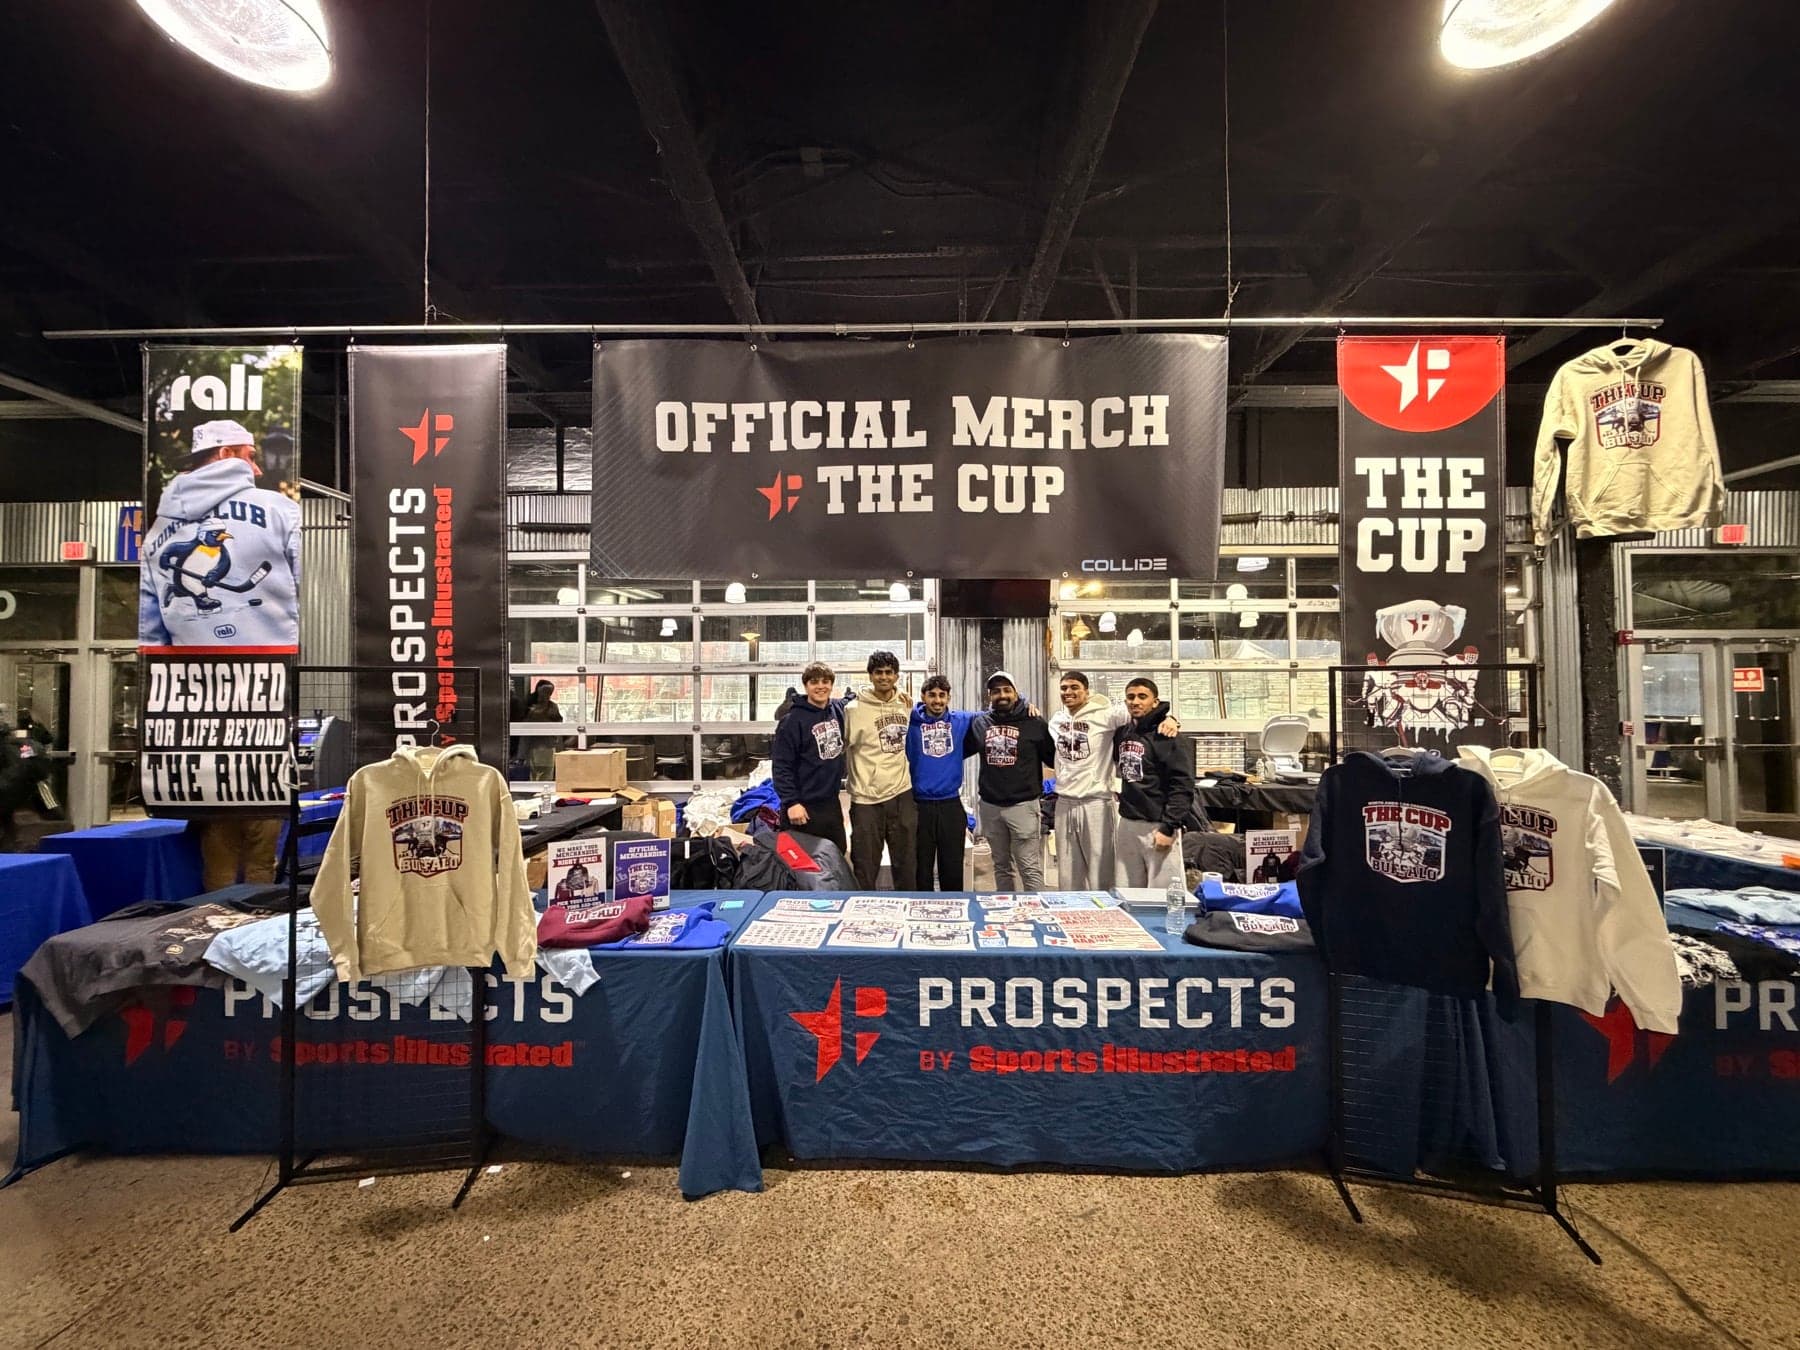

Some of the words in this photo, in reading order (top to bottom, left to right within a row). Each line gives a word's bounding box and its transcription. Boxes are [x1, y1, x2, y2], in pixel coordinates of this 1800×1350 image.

[655, 400, 927, 453] OFFICIAL
[952, 395, 1170, 450] MERCH
[817, 463, 934, 515] THE
[957, 463, 1065, 514] CUP
[1354, 457, 1485, 510] THE
[431, 487, 453, 626] Illustrated
[1081, 558, 1167, 571] COLLIDE
[1355, 517, 1486, 573] CUP
[147, 663, 286, 712] DESIGNED
[435, 629, 458, 723] Sports
[145, 719, 175, 746] FOR
[181, 719, 220, 746] LIFE
[223, 719, 286, 746] BEYOND
[147, 754, 204, 801] THE
[215, 754, 286, 801] RINK
[1364, 806, 1402, 823] THE
[1405, 808, 1450, 832] CUP
[1504, 806, 1557, 834] CUP
[224, 972, 573, 1024] POSTS
[919, 976, 1296, 1029] PROSPECTS
[393, 1036, 573, 1067] Illusrated
[920, 1051, 953, 1072] BY
[969, 1045, 1097, 1075] Sports
[1103, 1043, 1296, 1073] Illustrated
